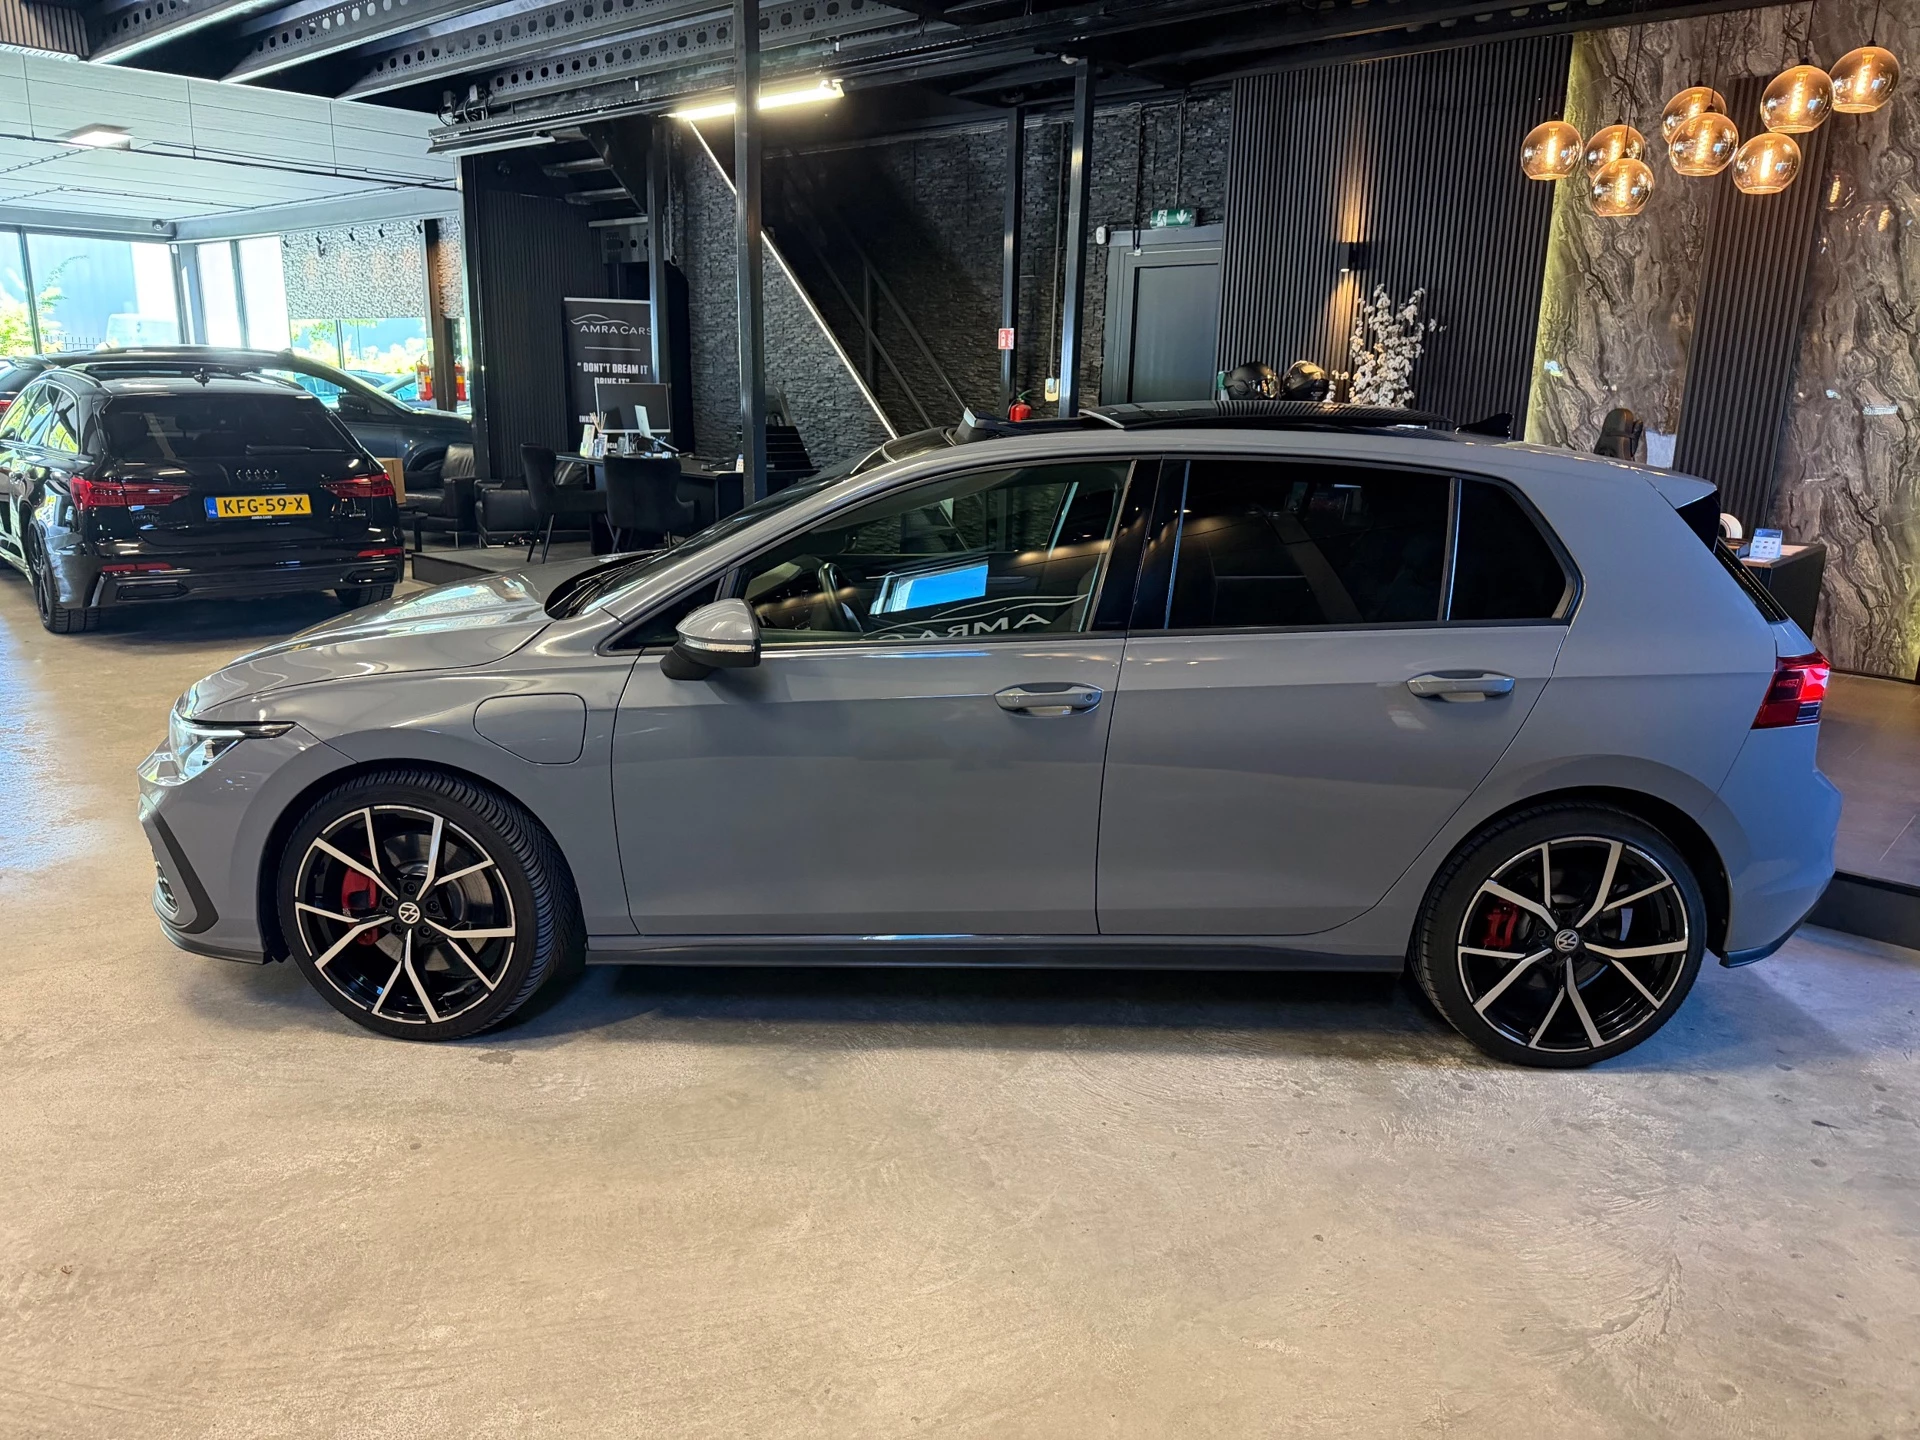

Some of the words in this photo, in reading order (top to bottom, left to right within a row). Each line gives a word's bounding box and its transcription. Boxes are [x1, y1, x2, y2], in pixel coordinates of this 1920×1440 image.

[580, 325, 618, 334] AMRA
[620, 326, 651, 335] CARS
[612, 364, 639, 374] DREAM
[640, 365, 648, 375] IT
[223, 497, 305, 515] KFG-59-X
